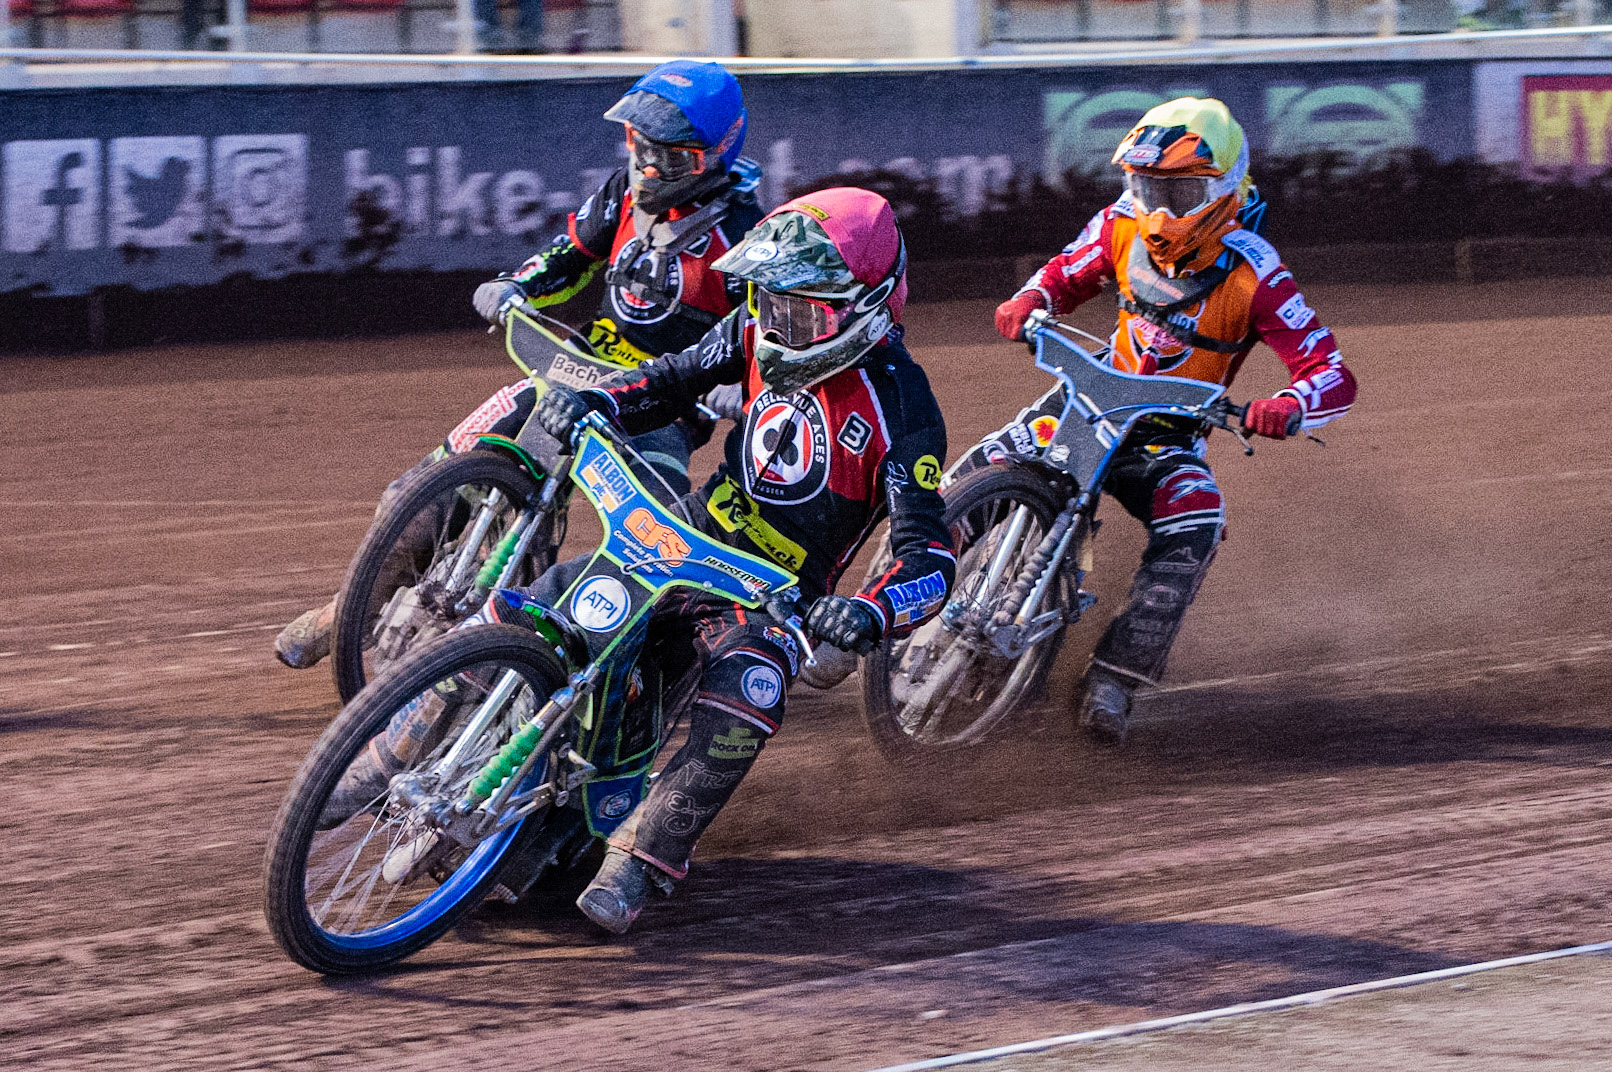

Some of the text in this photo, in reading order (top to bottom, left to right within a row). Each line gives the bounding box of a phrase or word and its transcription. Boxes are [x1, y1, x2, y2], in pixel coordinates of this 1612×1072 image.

[553, 356, 599, 385] Bach
[792, 393, 817, 419] VUE
[811, 424, 825, 464] ACES
[843, 420, 867, 448] 3
[594, 453, 635, 501] ALBON
[623, 507, 692, 567] CFS
[583, 590, 618, 619] ATPI
[886, 572, 946, 608] ALBON
[750, 677, 776, 694] ATPI
